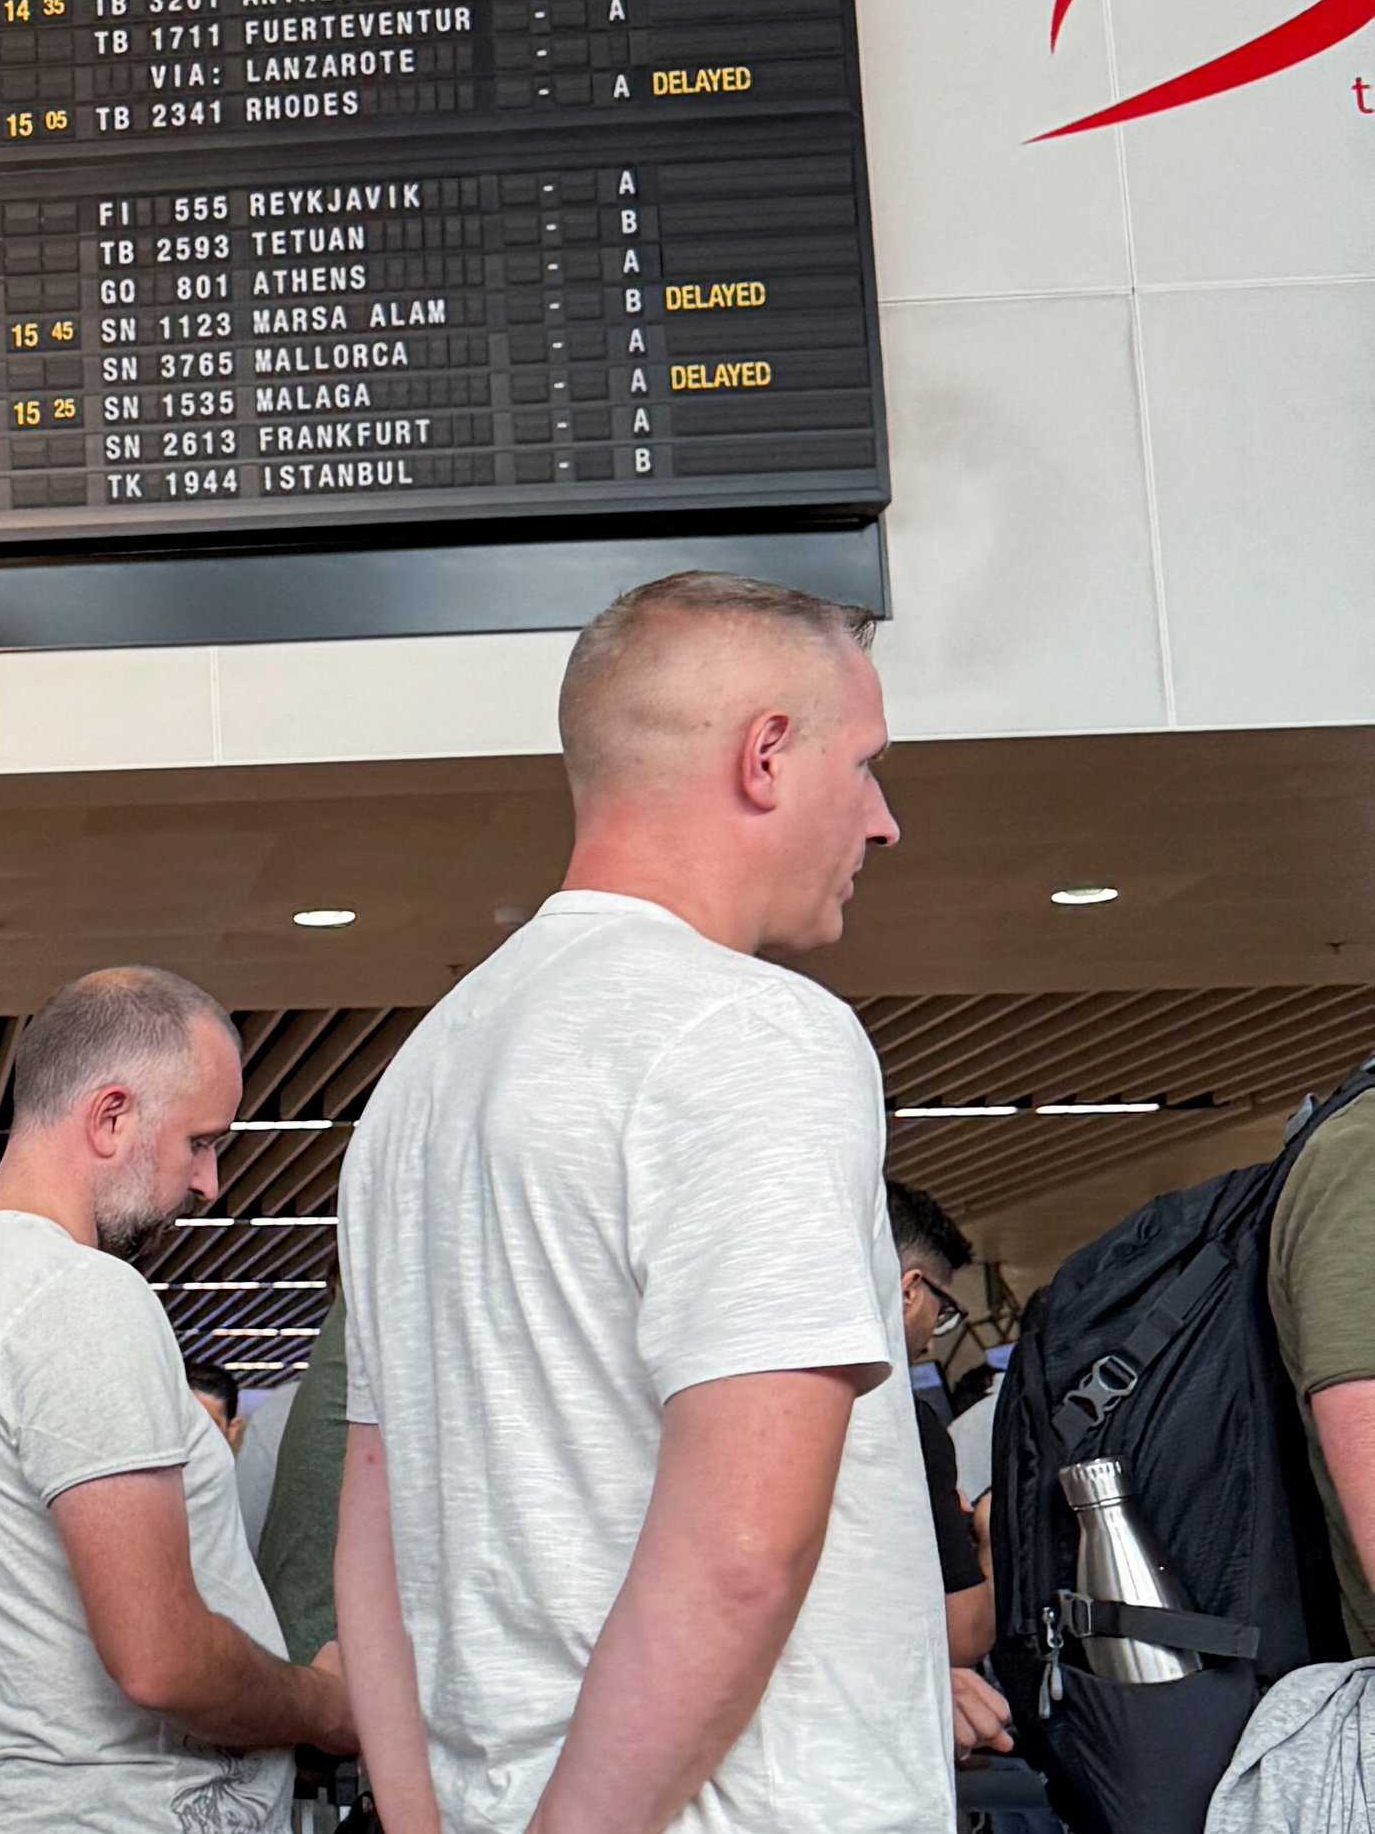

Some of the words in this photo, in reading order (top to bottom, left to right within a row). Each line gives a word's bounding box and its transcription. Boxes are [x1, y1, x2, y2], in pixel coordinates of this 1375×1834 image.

[246, 7, 469, 44] FUERTEVENTUR
[247, 49, 414, 82] LANZAROTE
[247, 91, 357, 121] RHODES
[653, 67, 750, 95] DELAYED
[250, 184, 419, 216] REYKJAVIK
[252, 227, 363, 255] TETUAN
[253, 306, 346, 333] MARSA
[370, 300, 445, 327] ALAM
[666, 282, 765, 310] DELAYED
[256, 342, 407, 371] MALLORCA
[671, 362, 770, 389] DELAYED
